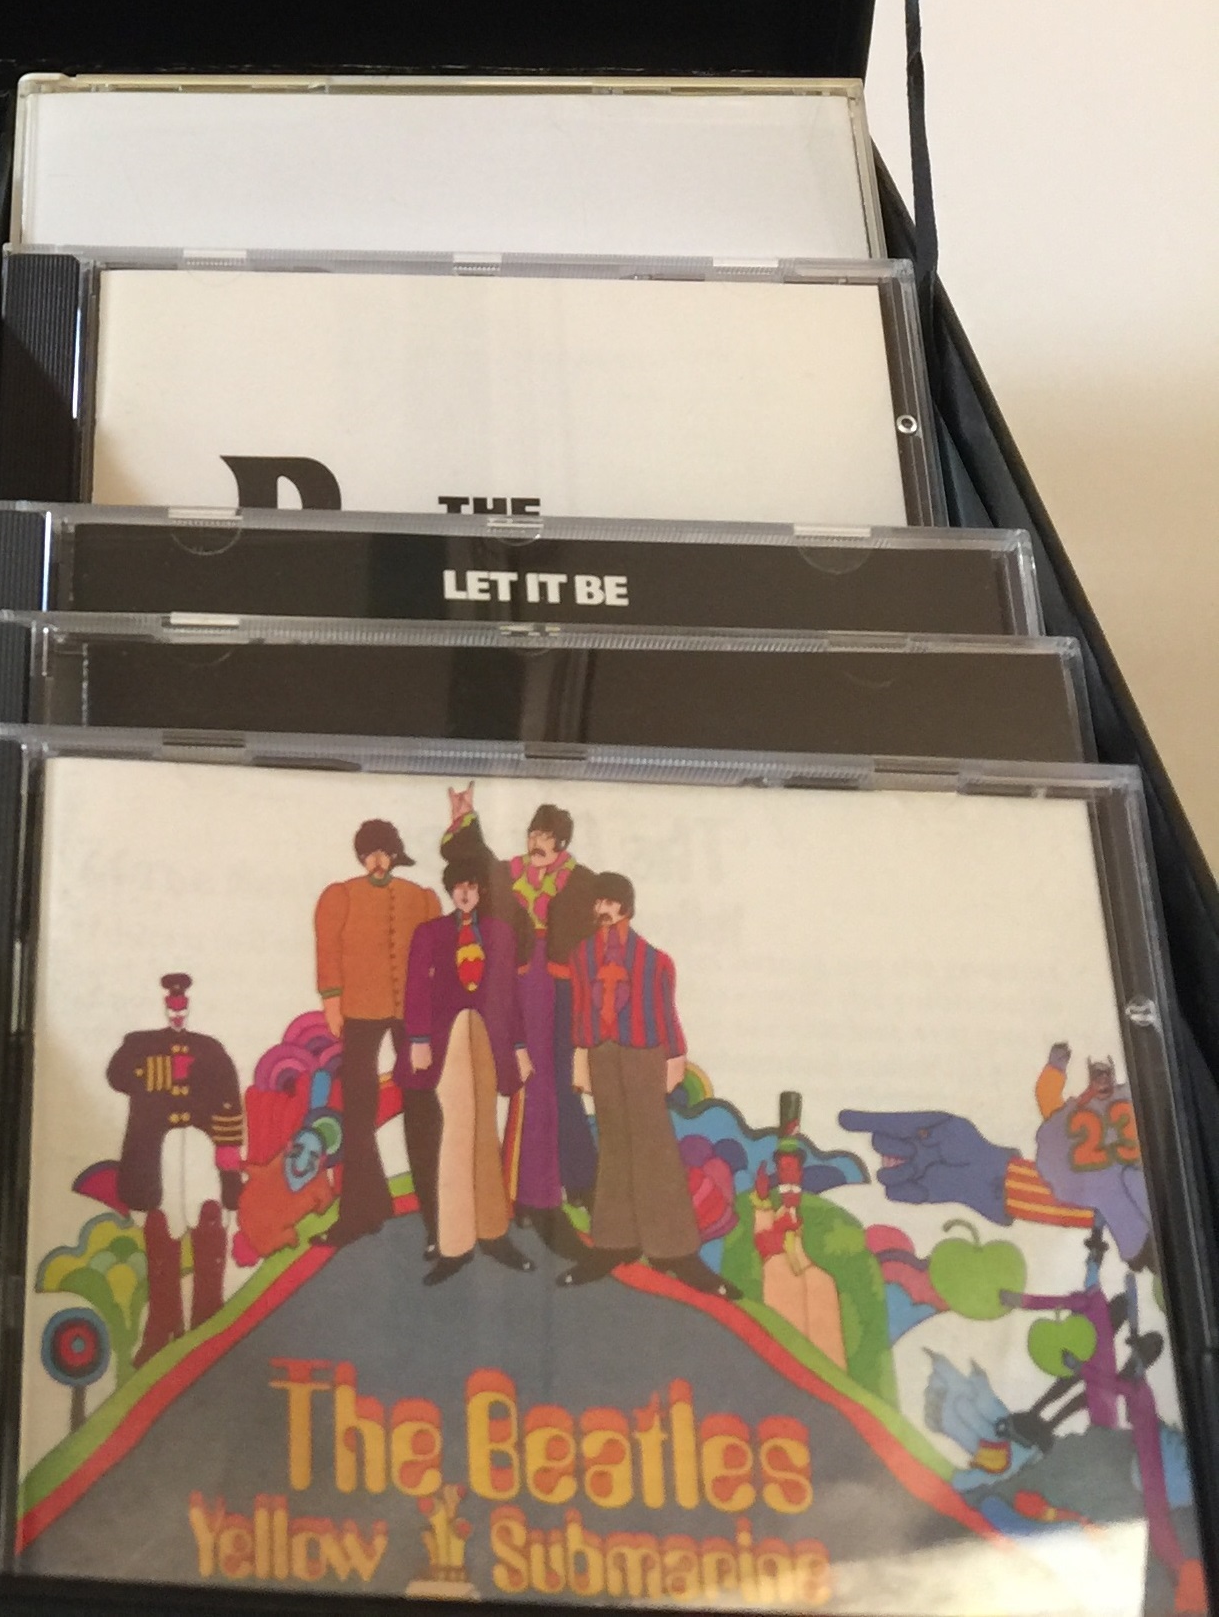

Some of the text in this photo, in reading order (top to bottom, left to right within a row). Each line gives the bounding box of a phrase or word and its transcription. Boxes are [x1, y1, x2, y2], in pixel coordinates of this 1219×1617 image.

[443, 569, 629, 606] LET IT BE
[268, 1356, 814, 1514] The Beatles
[188, 1489, 832, 1606] Yellow Submarine
